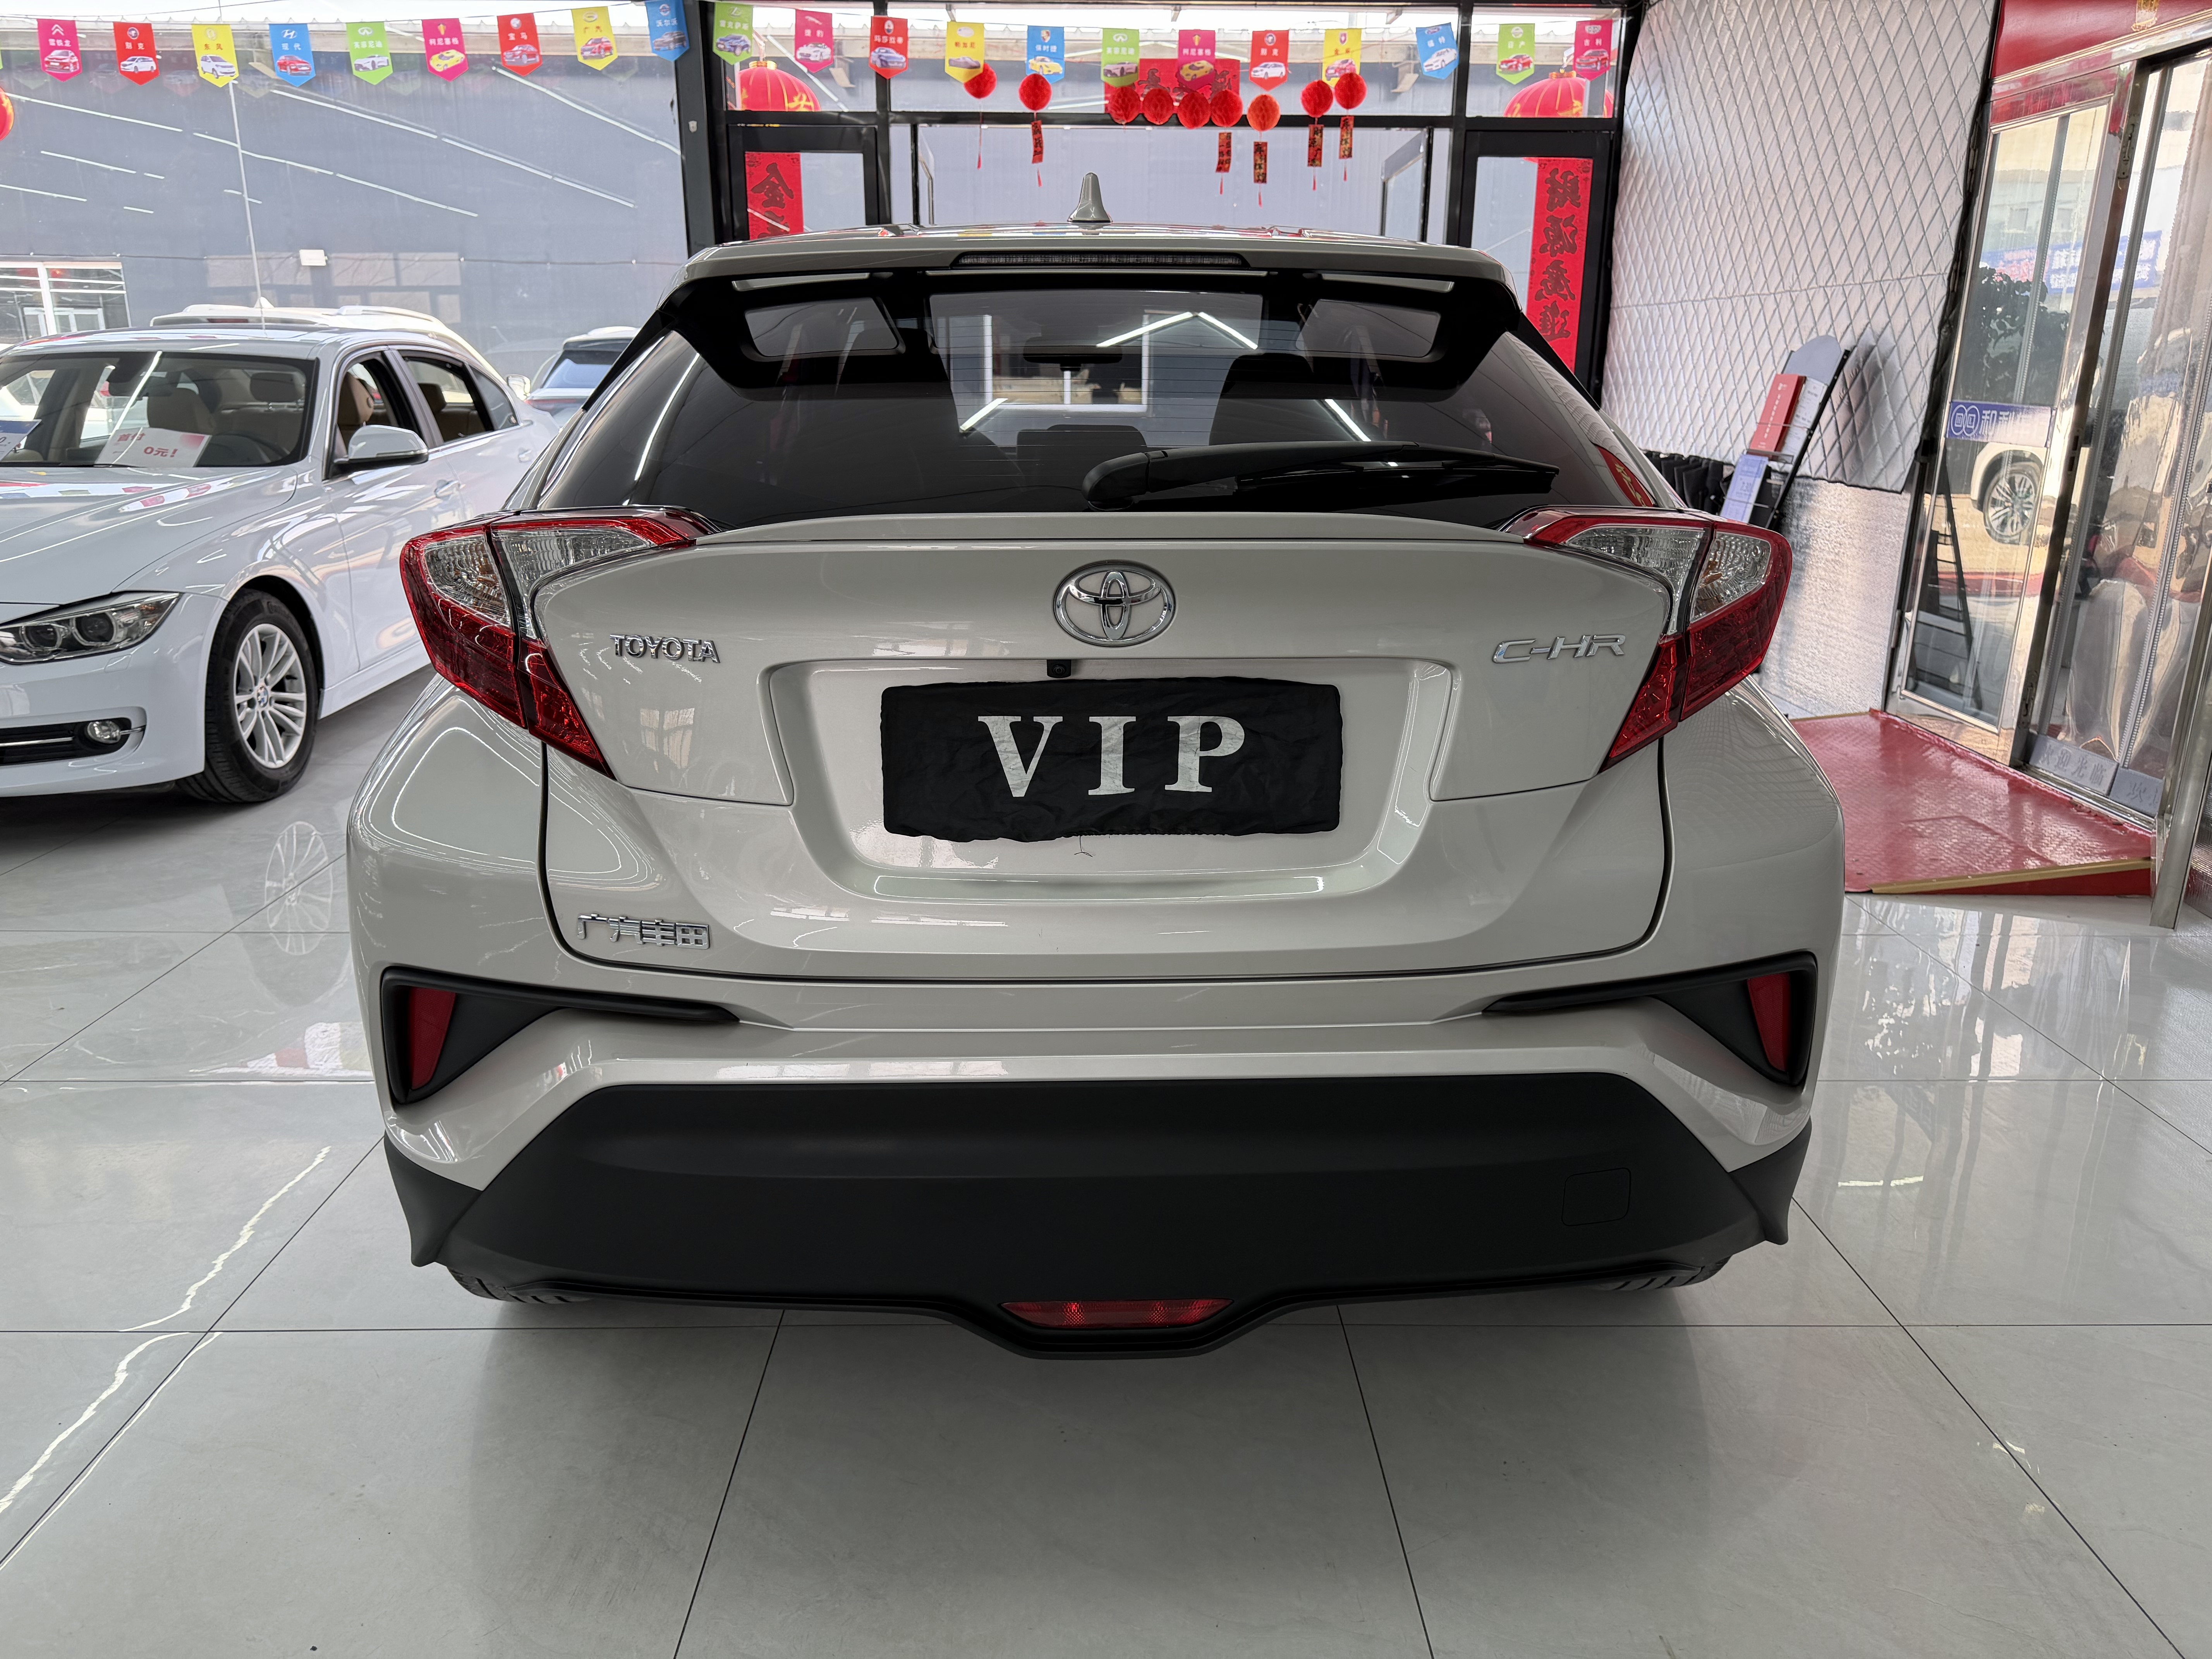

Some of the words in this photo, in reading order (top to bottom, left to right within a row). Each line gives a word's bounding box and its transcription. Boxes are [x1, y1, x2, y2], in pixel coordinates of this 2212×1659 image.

[48, 39, 71, 47] 雪铁龙
[508, 32, 528, 41] 宝马
[1260, 47, 1279, 57] 别克
[117, 433, 145, 442] 首付
[610, 634, 721, 663] TOYOTA
[1492, 634, 1626, 664] C-HR
[978, 716, 1245, 797] VIP
[577, 914, 710, 950] 广汽丰田
